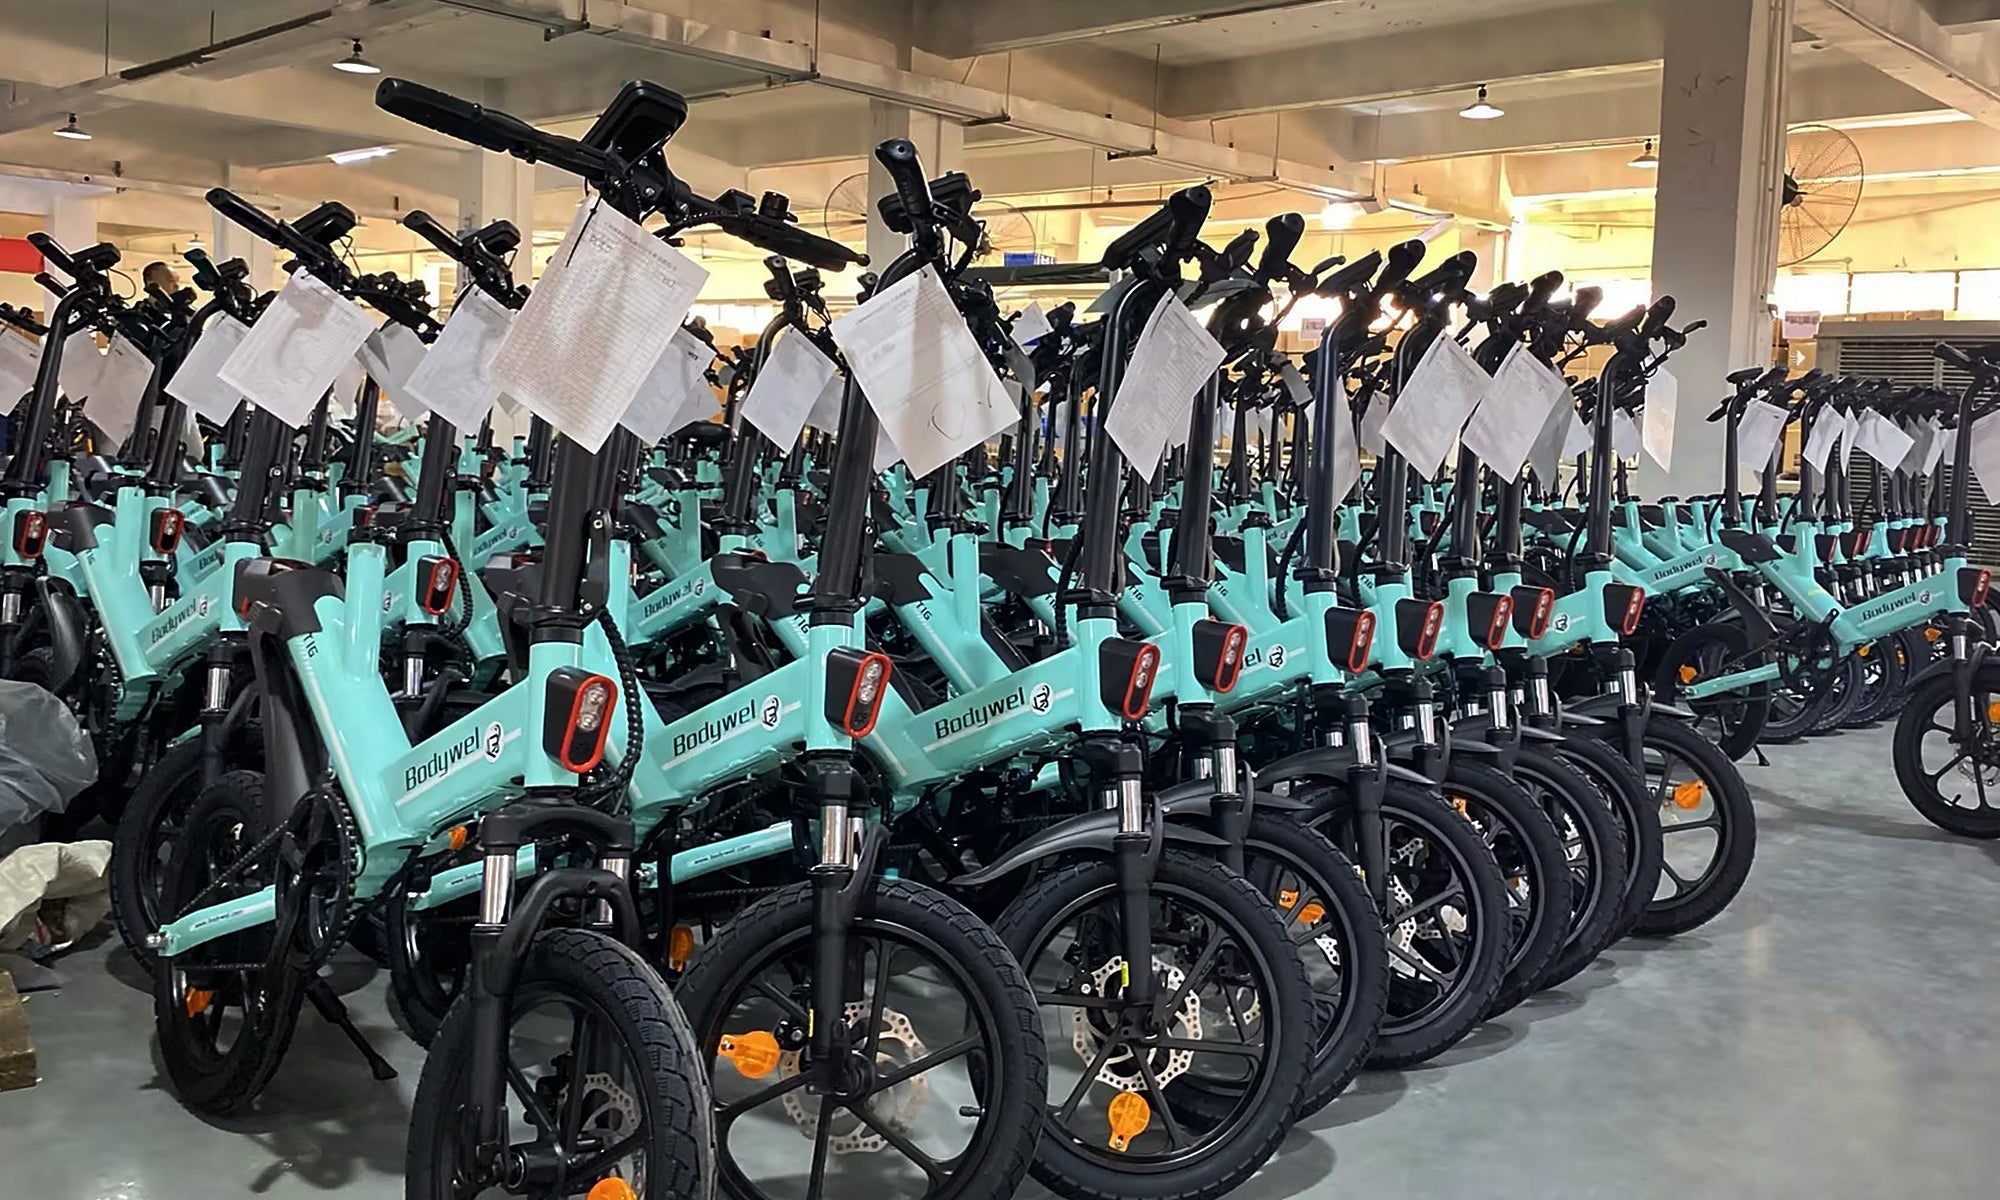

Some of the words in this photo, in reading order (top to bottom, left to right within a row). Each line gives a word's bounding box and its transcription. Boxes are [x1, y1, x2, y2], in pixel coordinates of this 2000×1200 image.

[1654, 555, 1703, 580] Bodywel
[151, 597, 197, 644] Bodywel
[644, 580, 692, 618] Bodywel
[1862, 591, 1917, 621] Bodywel
[673, 698, 756, 757] Bodywel
[935, 686, 1025, 740] Bodywel
[405, 726, 479, 792] Bodywel
